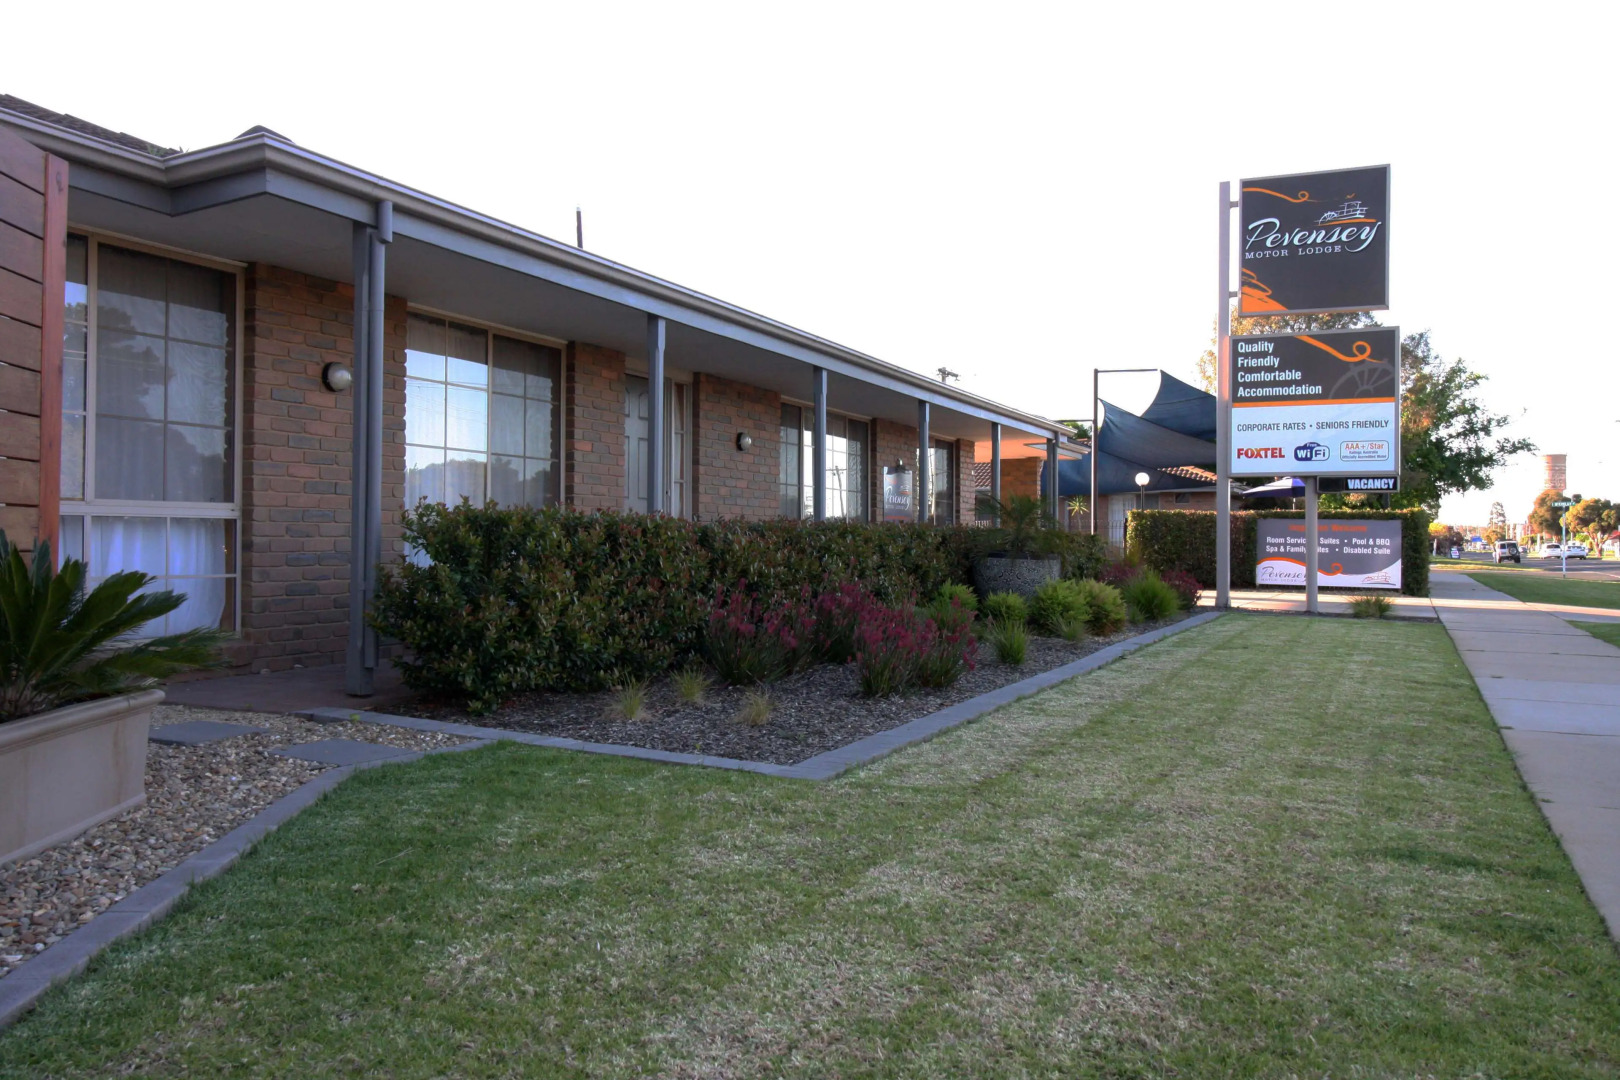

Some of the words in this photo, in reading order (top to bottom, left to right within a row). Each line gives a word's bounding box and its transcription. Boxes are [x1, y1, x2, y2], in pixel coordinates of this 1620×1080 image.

[1246, 217, 1382, 253] Pevensey
[1245, 250, 1288, 259] MOTOR
[1298, 245, 1342, 256] LODGE
[1237, 341, 1275, 354] Quality
[1237, 355, 1280, 368] Friendly
[1237, 369, 1302, 383] Comfortable
[1237, 384, 1322, 398] Accommodation
[1237, 423, 1280, 432] CORPORATE
[1282, 422, 1306, 431] RATES
[1315, 421, 1350, 430] SENIORS
[1351, 419, 1389, 429] FRIENDLY
[1237, 447, 1286, 459] FOXTEL
[1347, 478, 1395, 490] VACANCY
[1266, 536, 1285, 544] Room
[1286, 536, 1307, 544] Servic
[1319, 537, 1340, 545] Suites
[1368, 538, 1374, 546] &
[1375, 538, 1391, 546] BBQ
[1265, 545, 1278, 553] Spa
[1373, 547, 1391, 555] Suite
